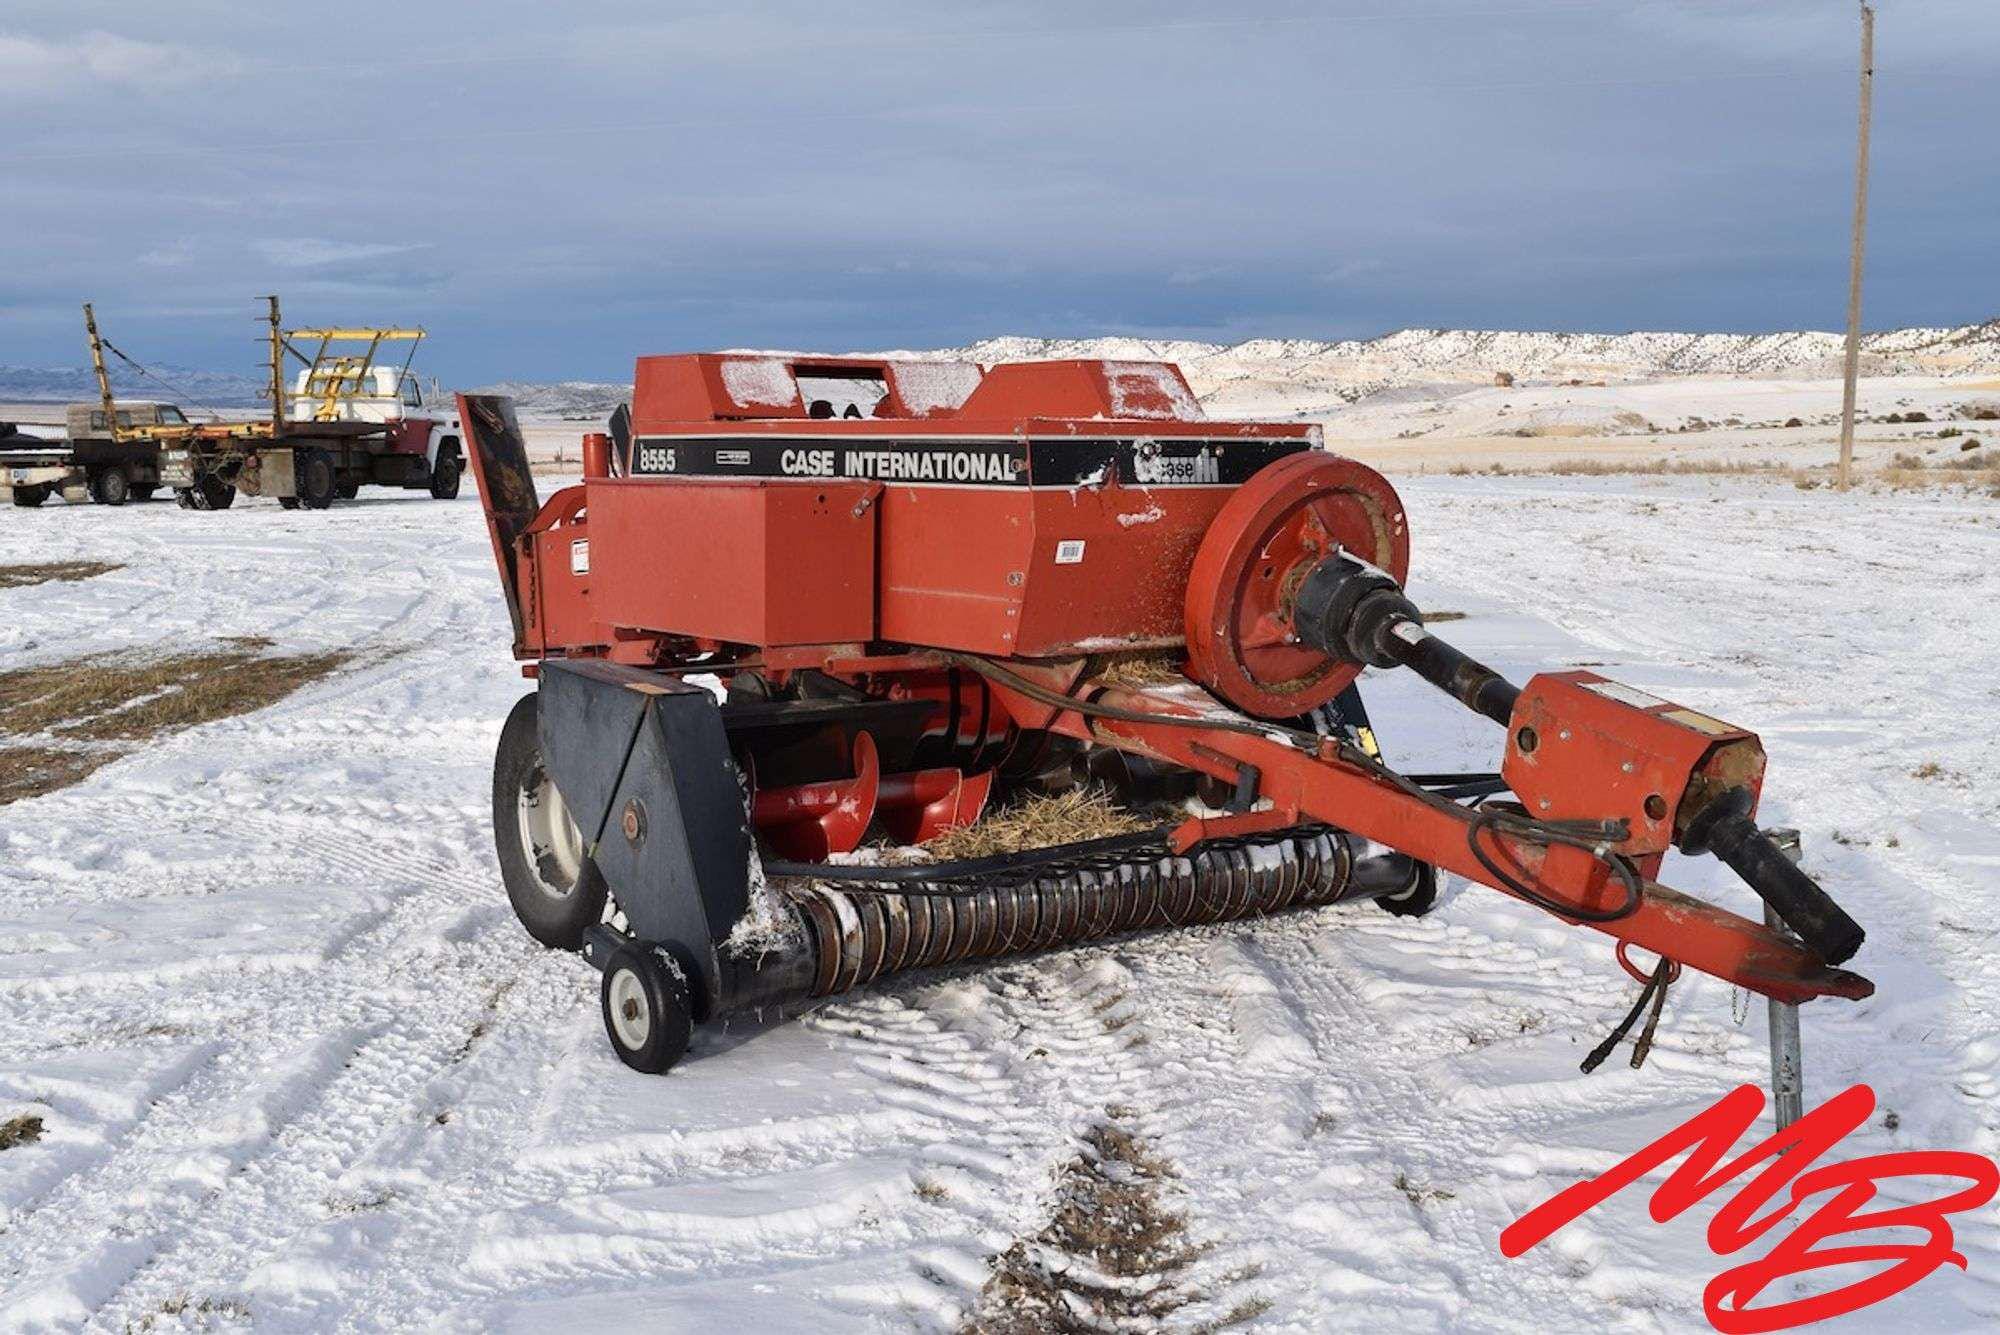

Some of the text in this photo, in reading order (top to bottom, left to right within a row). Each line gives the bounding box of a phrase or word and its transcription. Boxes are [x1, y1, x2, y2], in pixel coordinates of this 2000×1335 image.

[640, 448, 676, 471] 8555
[780, 449, 835, 476] CASE
[844, 451, 1017, 482] INTERNATIONAL
